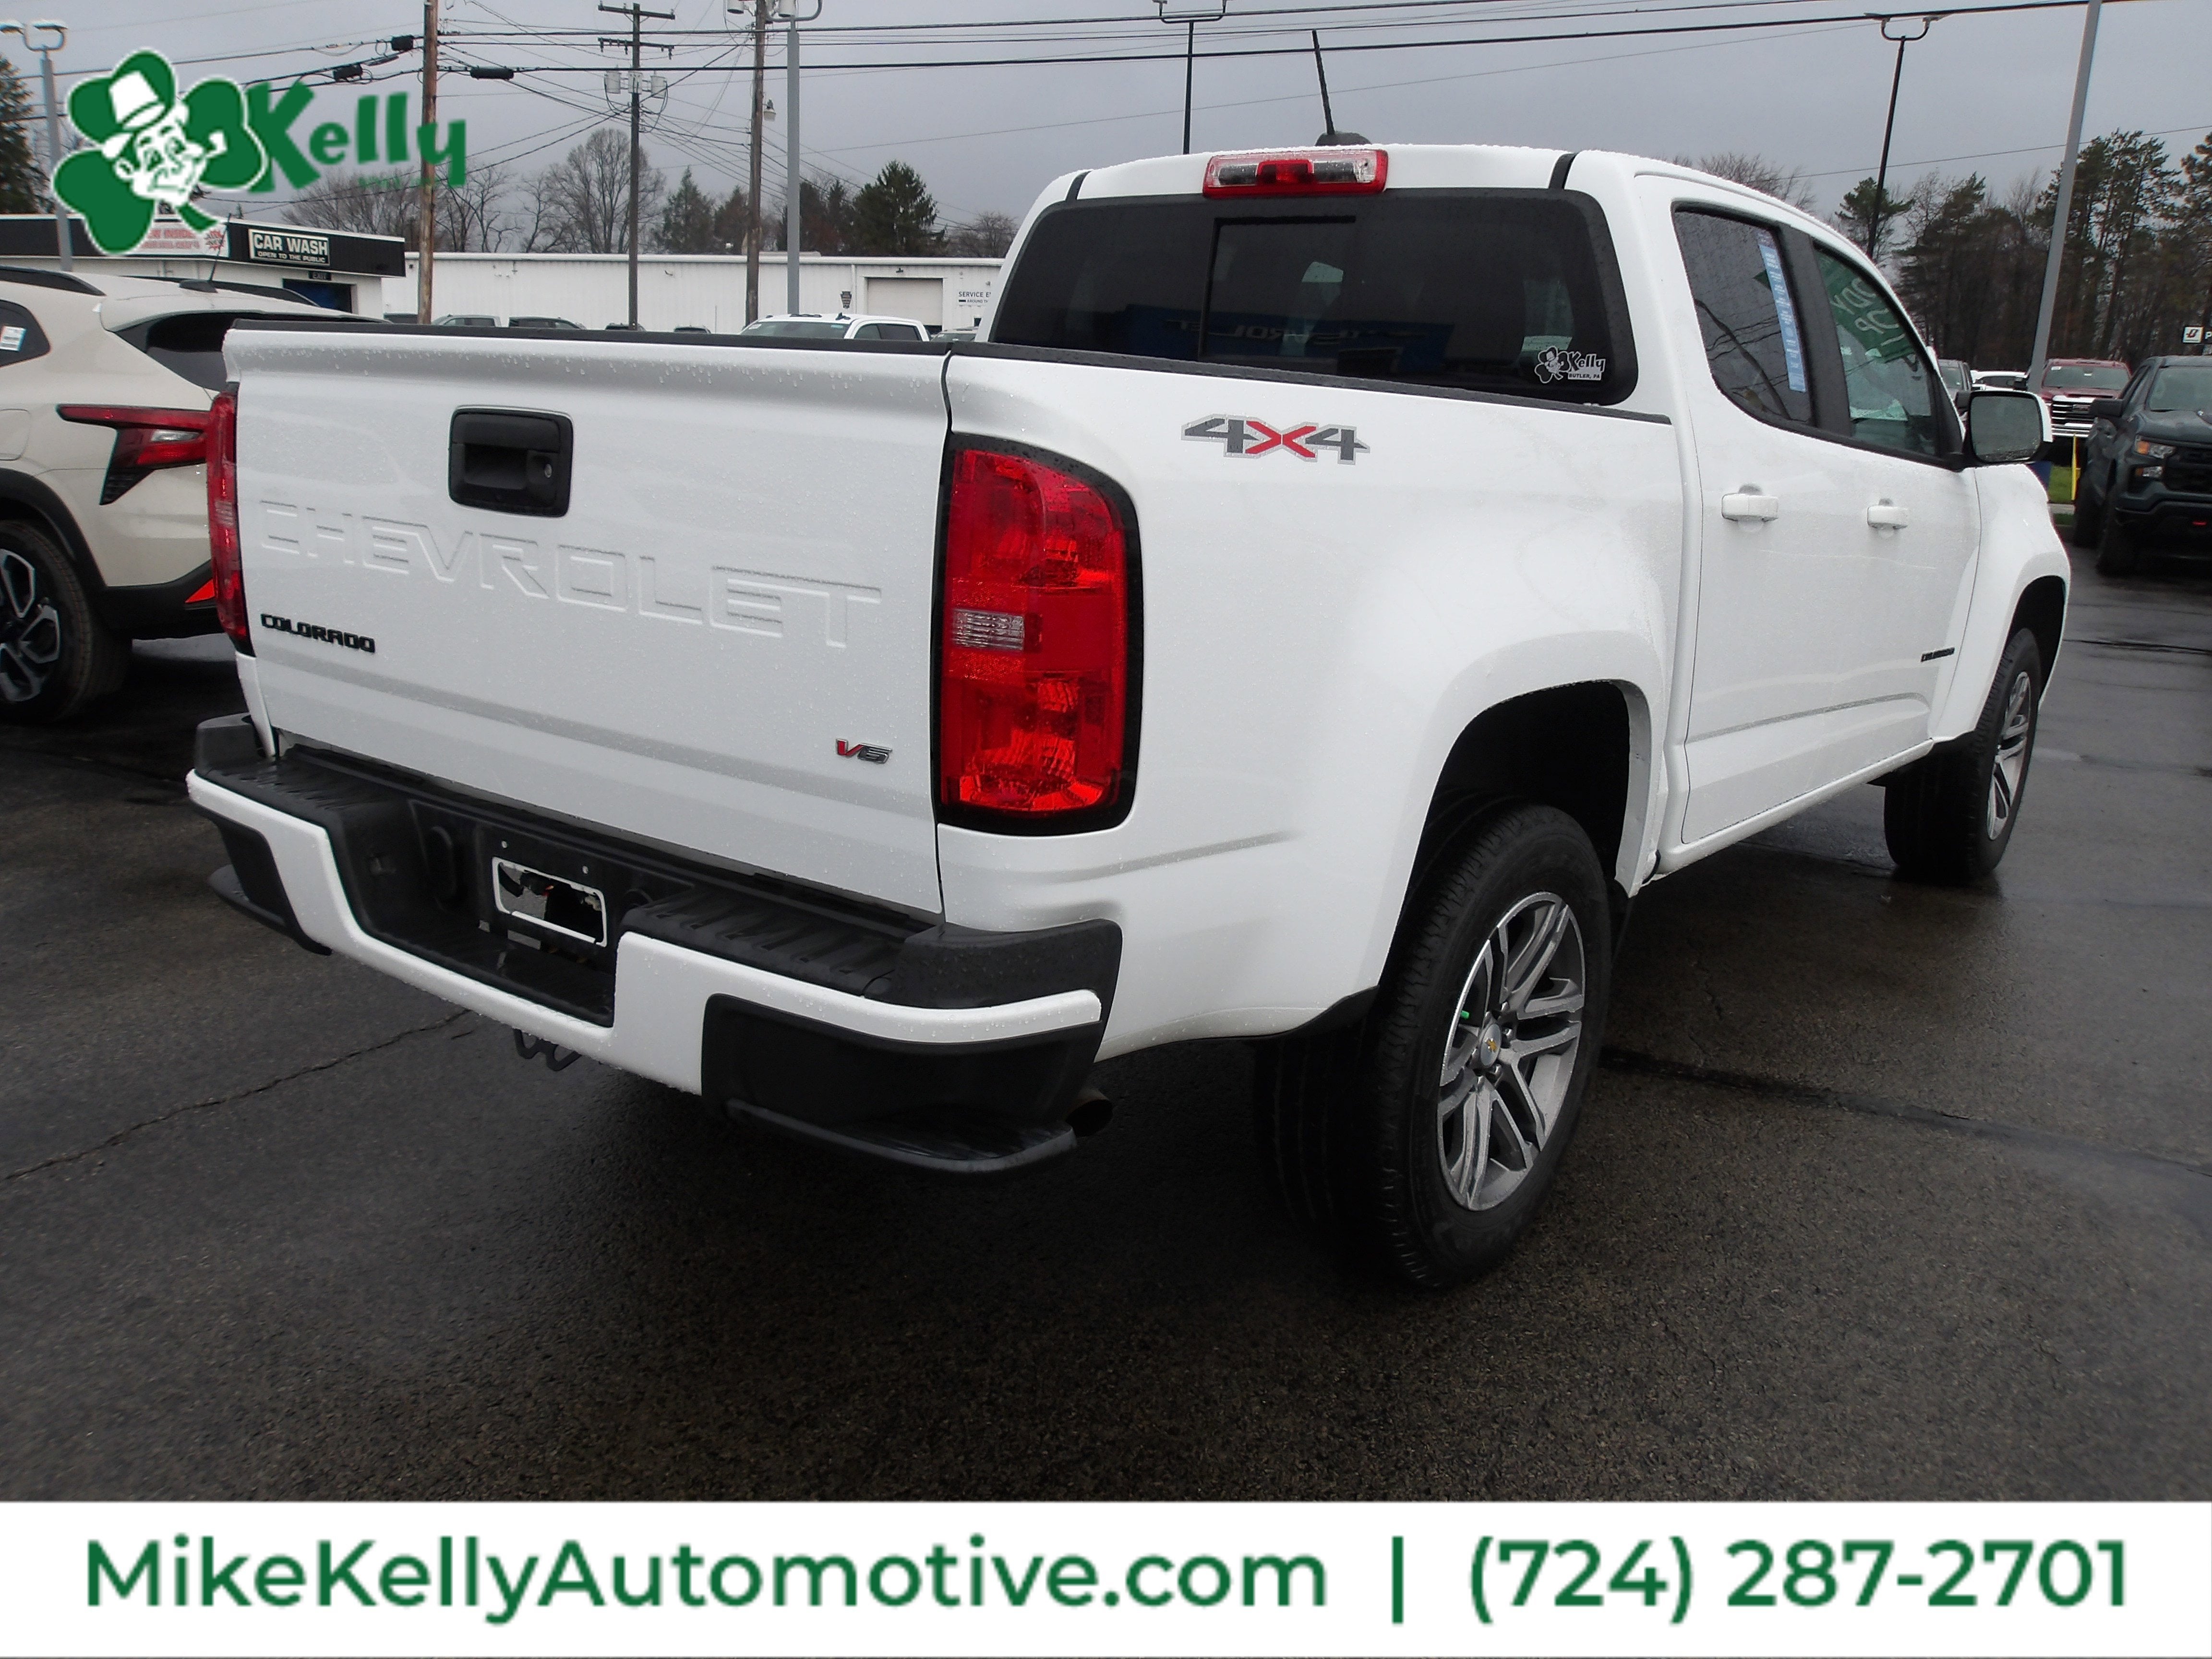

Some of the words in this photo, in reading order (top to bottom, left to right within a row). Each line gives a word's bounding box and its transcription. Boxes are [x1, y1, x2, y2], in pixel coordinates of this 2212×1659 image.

[254, 234, 283, 251] CAR
[287, 238, 328, 255] WASH
[1568, 351, 1606, 373] Kelly
[261, 501, 881, 648] CHEVROLET
[261, 613, 376, 653] COLORADO
[836, 739, 892, 764] V6
